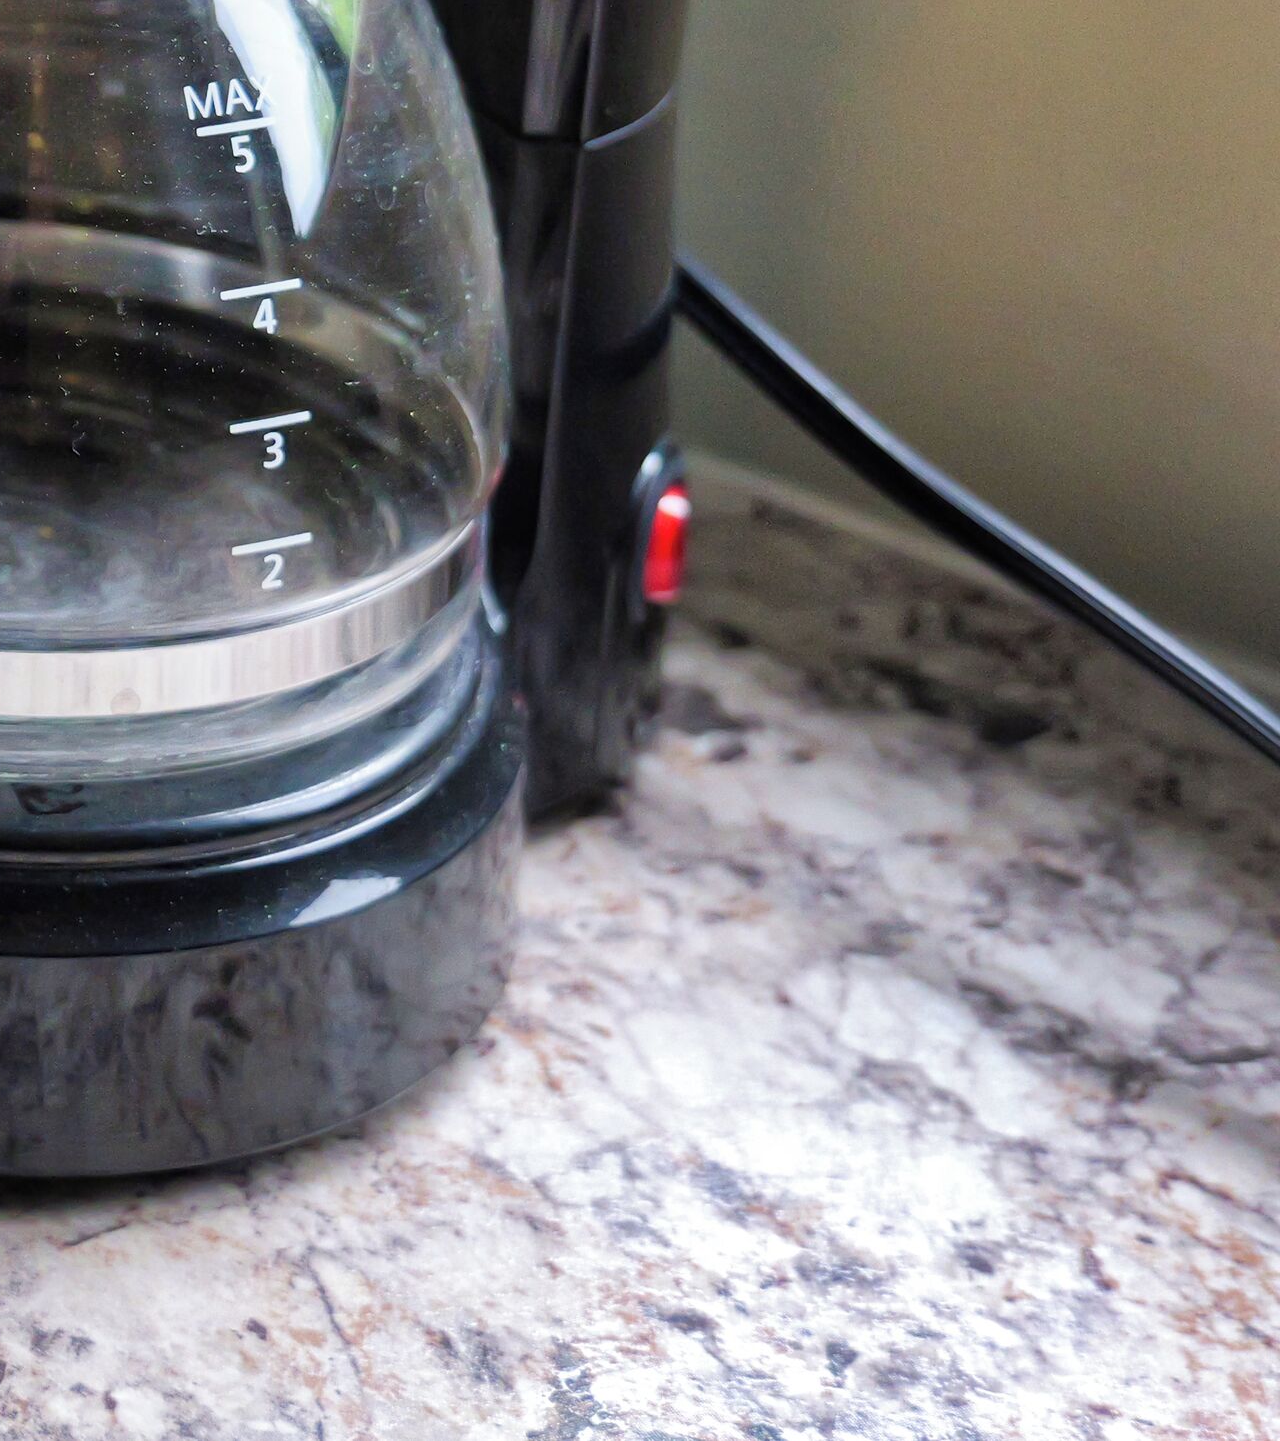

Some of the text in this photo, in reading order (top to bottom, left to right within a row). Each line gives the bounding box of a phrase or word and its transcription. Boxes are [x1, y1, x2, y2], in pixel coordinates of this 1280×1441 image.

[230, 134, 256, 174] 5
[252, 298, 278, 335] 4
[263, 431, 286, 470] 3
[261, 553, 284, 590] 2
